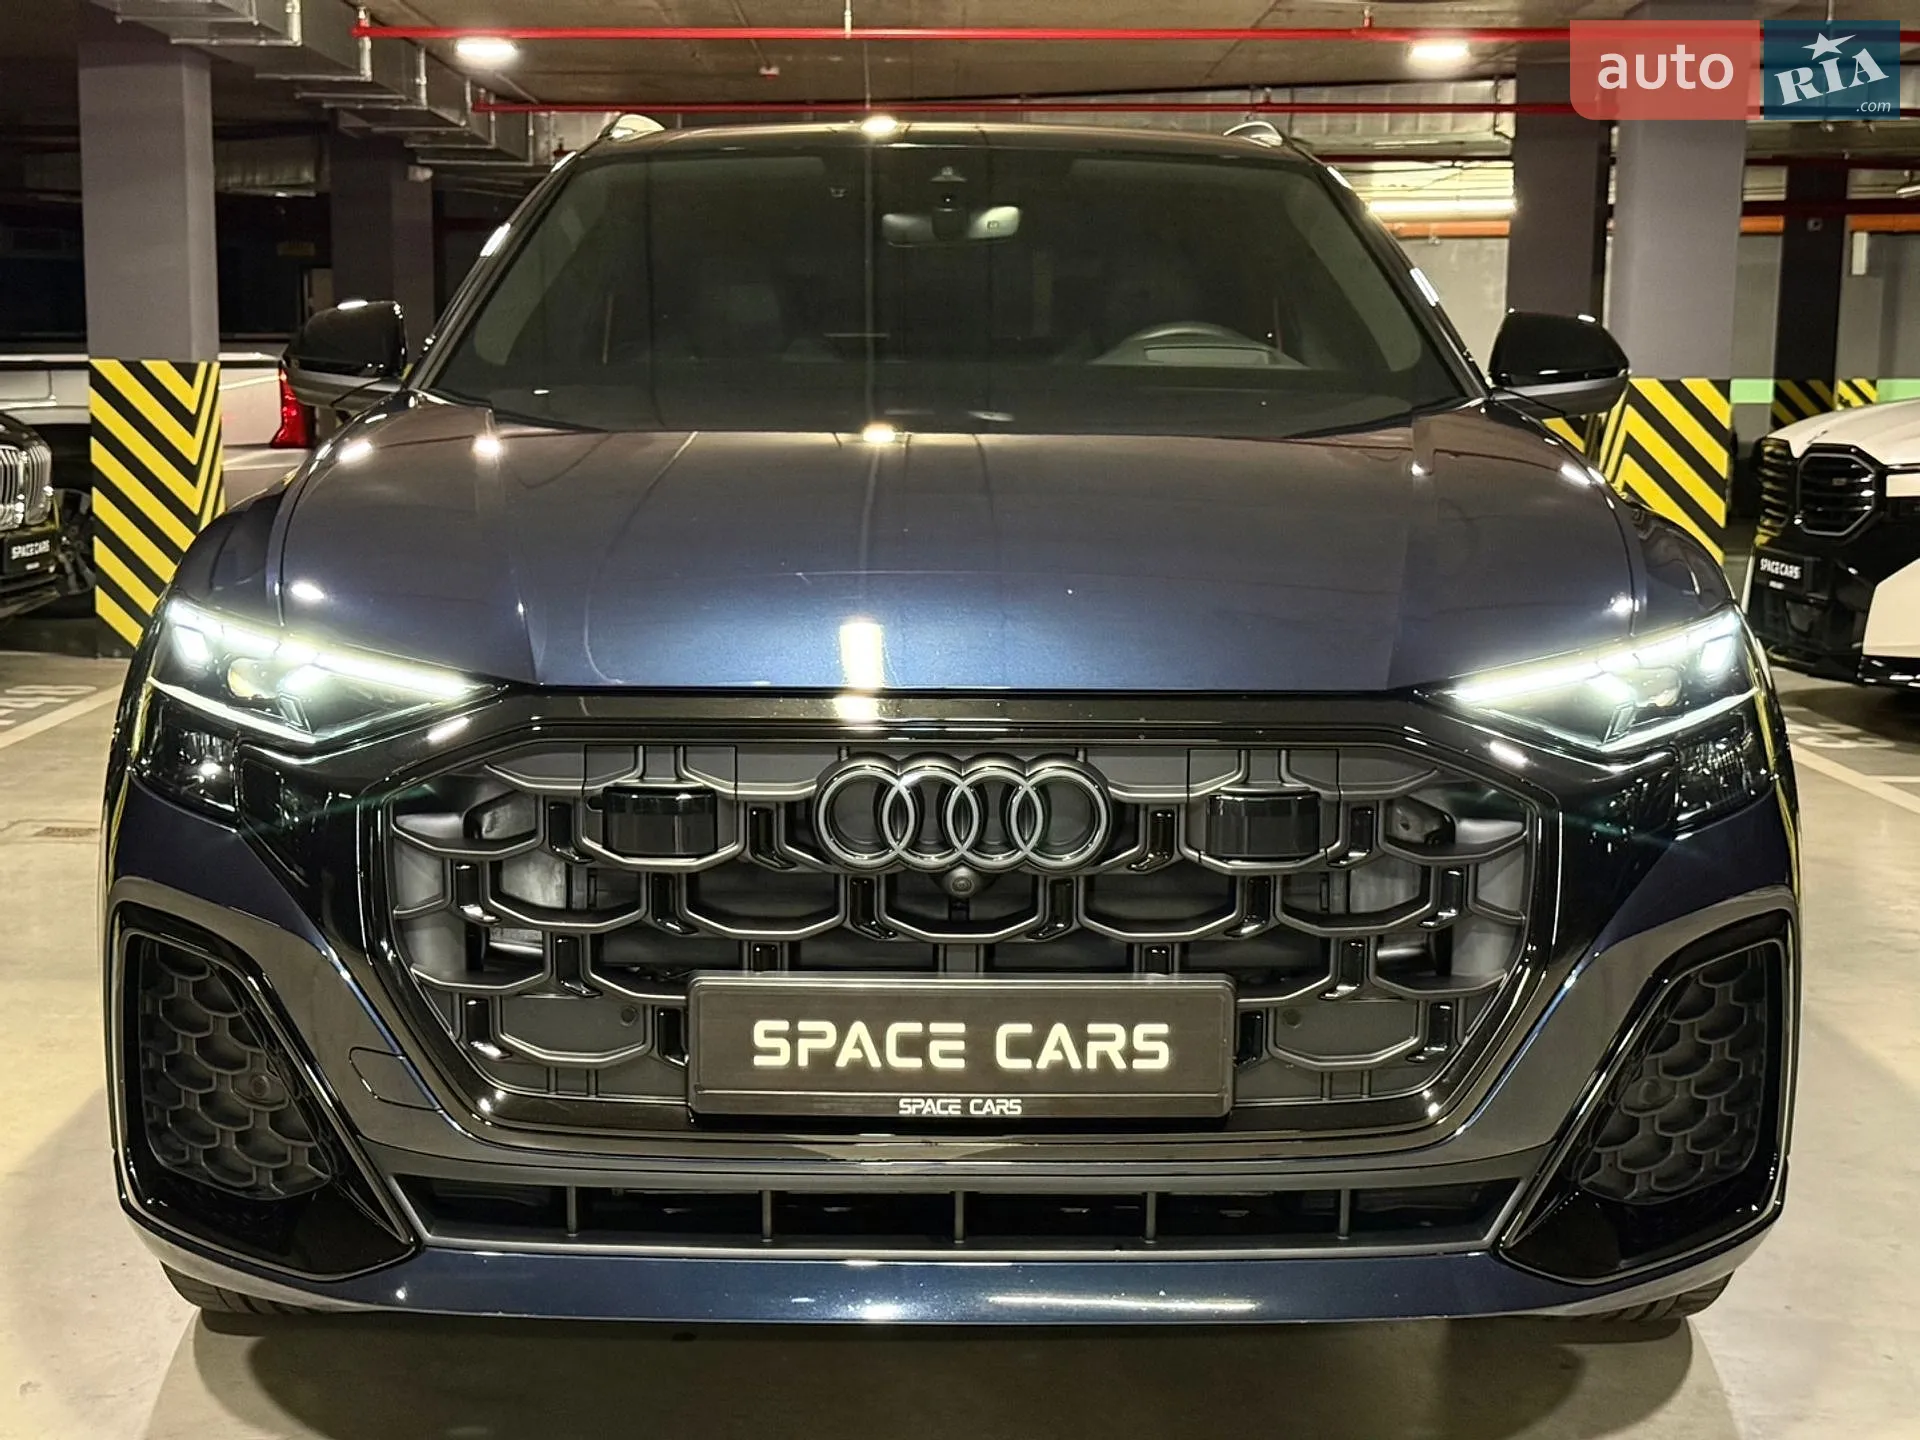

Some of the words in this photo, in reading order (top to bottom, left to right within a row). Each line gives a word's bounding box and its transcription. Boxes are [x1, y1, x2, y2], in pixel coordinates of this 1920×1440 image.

[753, 1020, 966, 1070] SPACE
[995, 1022, 1170, 1071] CARS
[898, 1098, 962, 1116] SPACE
[969, 1098, 1023, 1116] CARS
